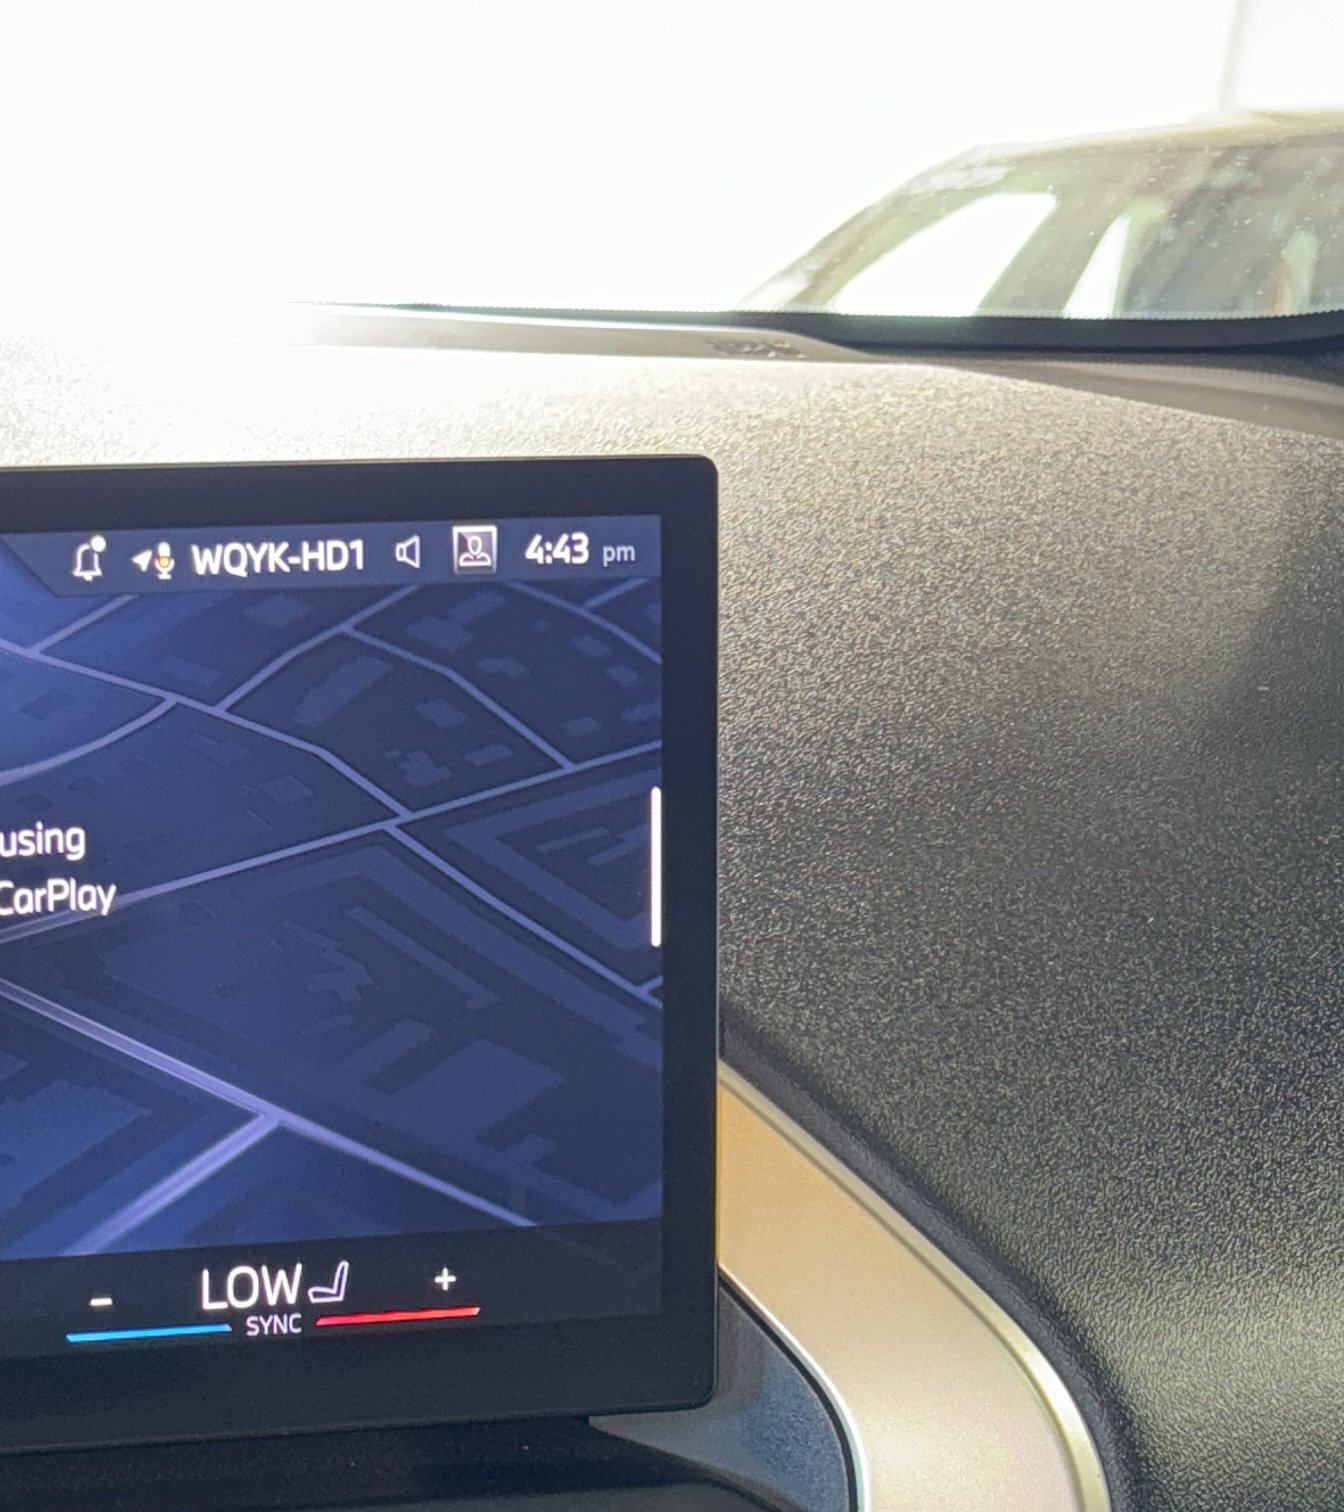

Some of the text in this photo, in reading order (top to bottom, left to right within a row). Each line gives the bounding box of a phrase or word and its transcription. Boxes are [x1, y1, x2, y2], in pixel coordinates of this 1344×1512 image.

[192, 539, 365, 577] WQYK-HD1
[524, 532, 635, 568] 4:43 pm
[202, 1261, 303, 1310] LOW
[246, 1313, 302, 1337] SYNC
